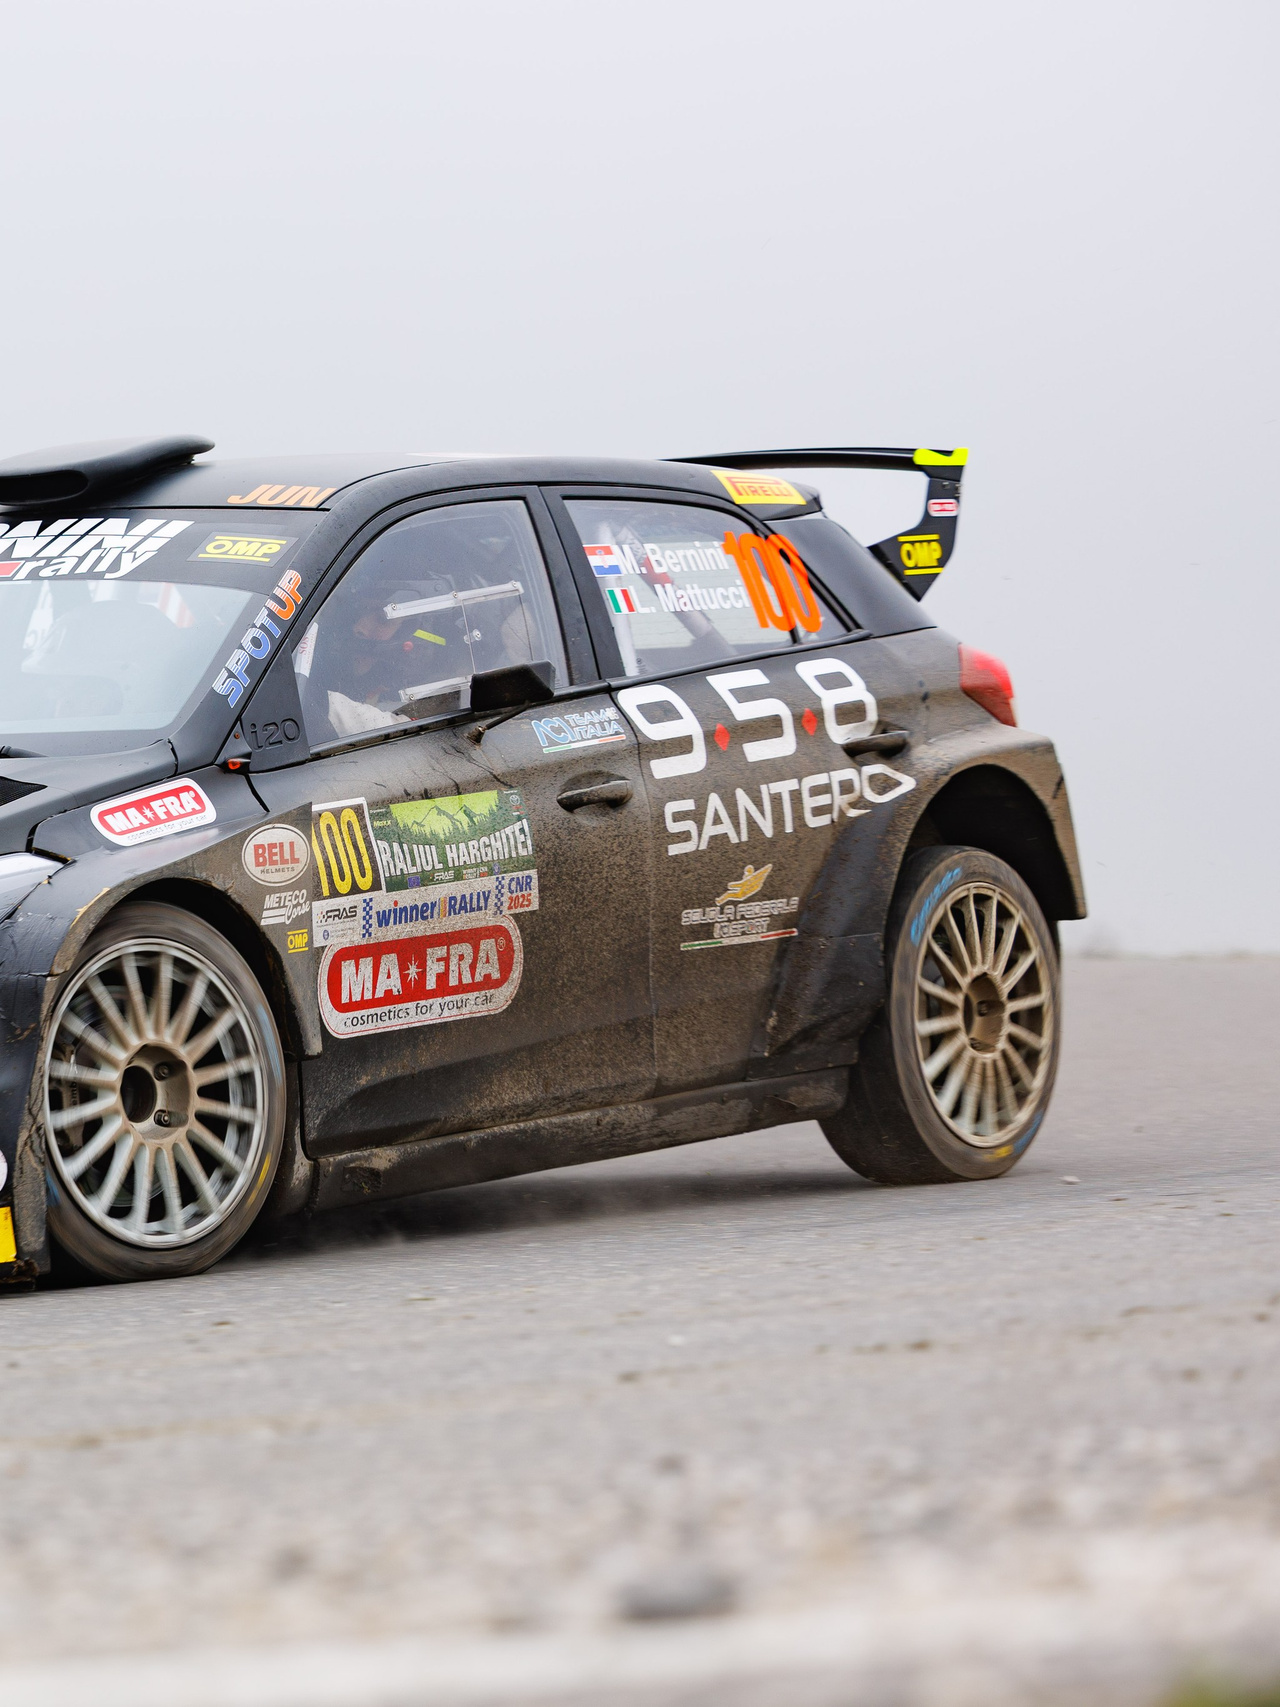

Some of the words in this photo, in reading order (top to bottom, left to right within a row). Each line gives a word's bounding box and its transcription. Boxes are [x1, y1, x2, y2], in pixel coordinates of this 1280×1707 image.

[227, 484, 337, 507] JUN
[726, 476, 795, 497] PIRELLI
[205, 540, 281, 557] OMP
[614, 545, 647, 574] M.
[645, 541, 729, 574] Bernini
[900, 541, 942, 568] OMP
[13, 546, 158, 580] rally
[722, 531, 822, 632] 100
[629, 586, 656, 613] L.
[655, 580, 751, 612] Mattucci
[564, 709, 608, 727] TEAM
[573, 721, 624, 740] ITALIA
[250, 717, 301, 750] i20
[664, 764, 917, 856] SANTERO
[253, 841, 300, 868] BELL
[377, 840, 444, 878] RALIUL
[445, 818, 533, 867] HARGHITEI
[260, 866, 295, 875] HELMETS
[508, 875, 533, 894] CNR
[264, 889, 307, 909] METECO
[376, 900, 440, 928] winner
[448, 889, 492, 917] RALLY
[507, 893, 532, 910] 2025
[284, 900, 311, 925] Corse
[325, 905, 358, 922] FRAS
[287, 932, 309, 949] OMP
[344, 1005, 410, 1028] cosmetics
[415, 1002, 434, 1017] for
[439, 997, 469, 1017] your
[473, 992, 494, 1007] car
